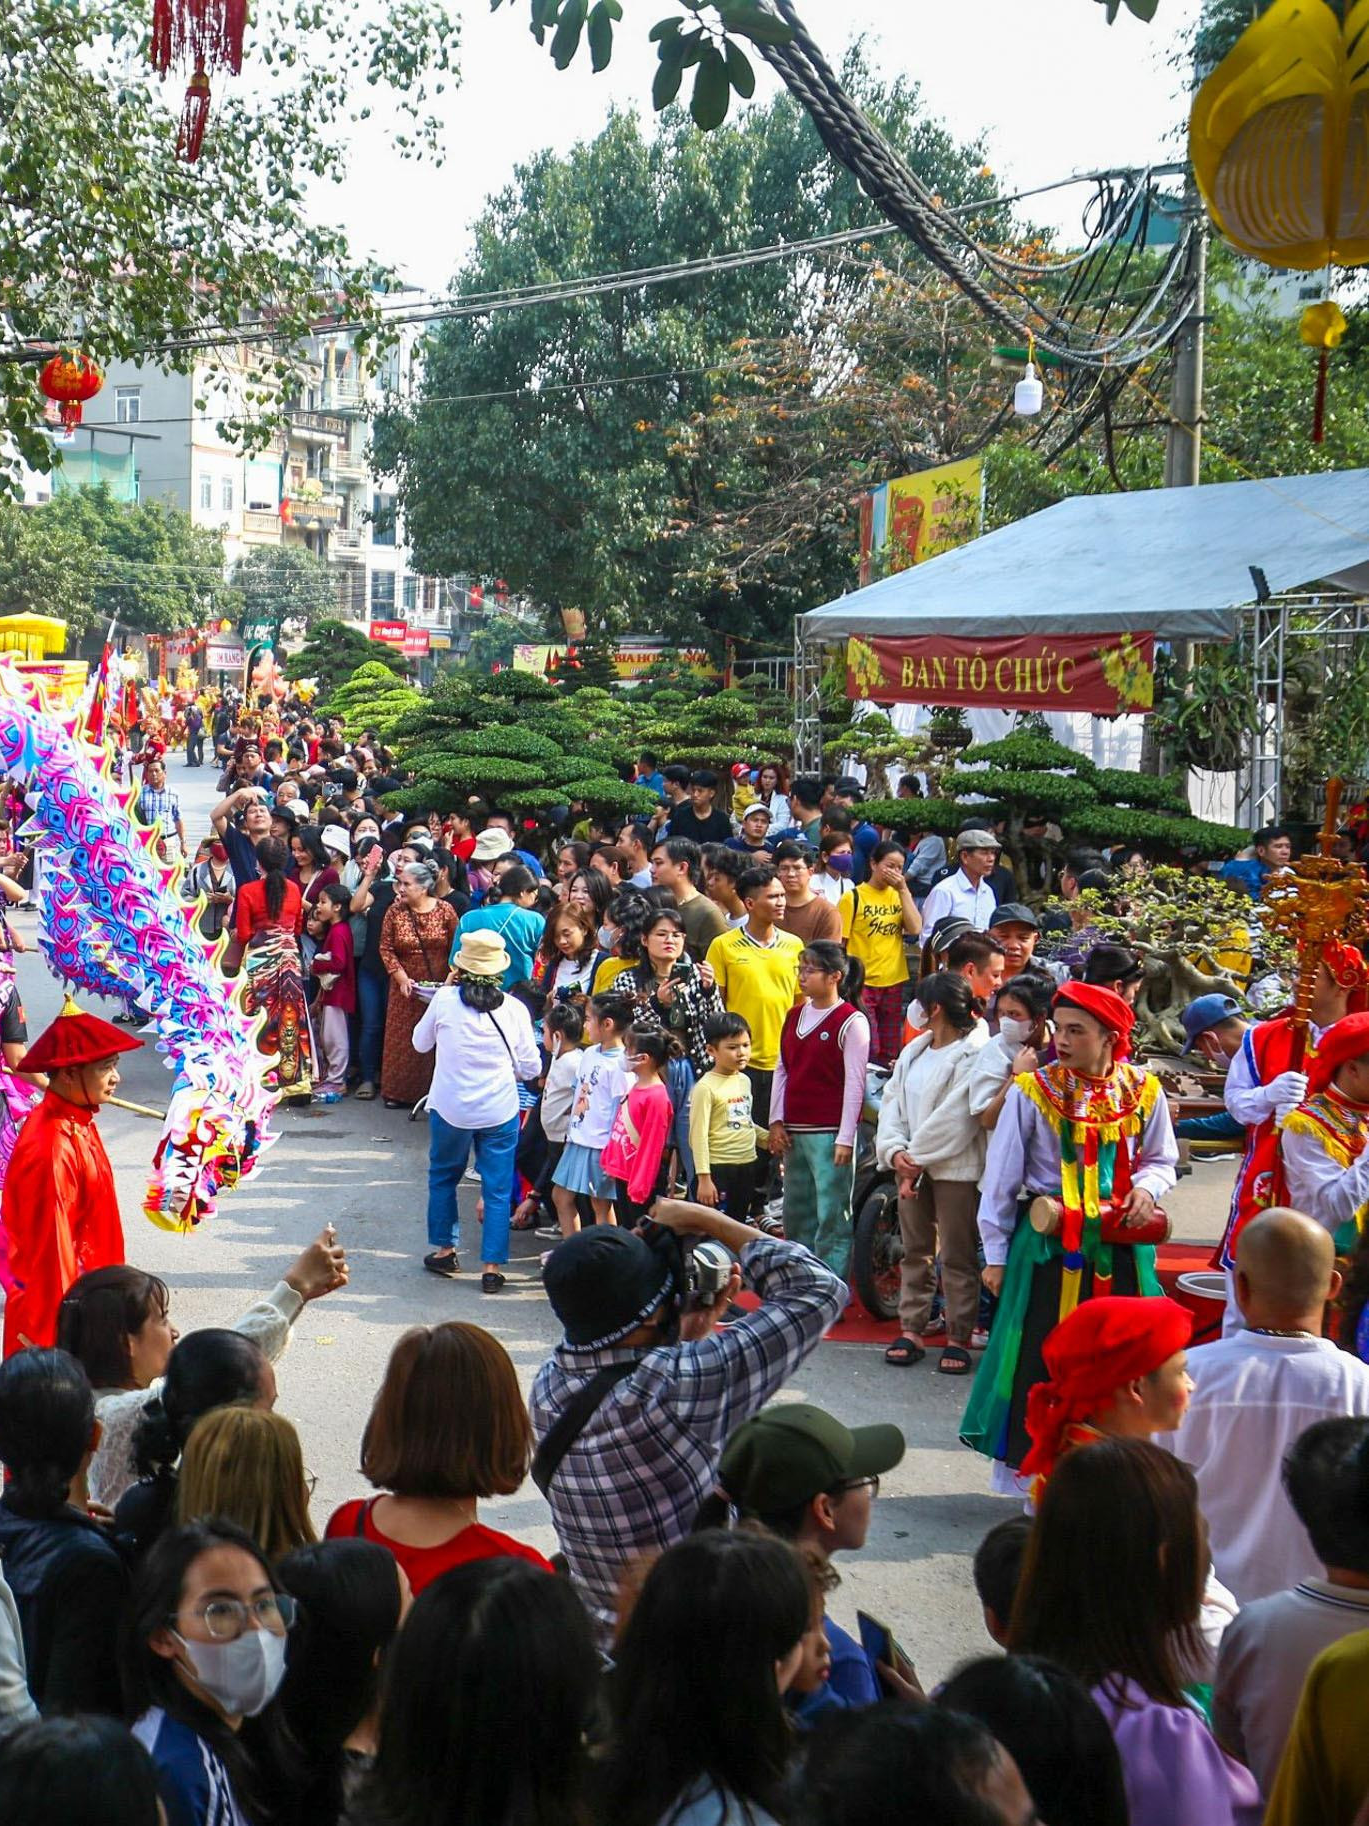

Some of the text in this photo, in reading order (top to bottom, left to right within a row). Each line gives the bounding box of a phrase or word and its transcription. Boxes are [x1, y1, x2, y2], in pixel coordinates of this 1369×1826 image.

[901, 646, 1074, 694] BAN TỔ CHỨC
